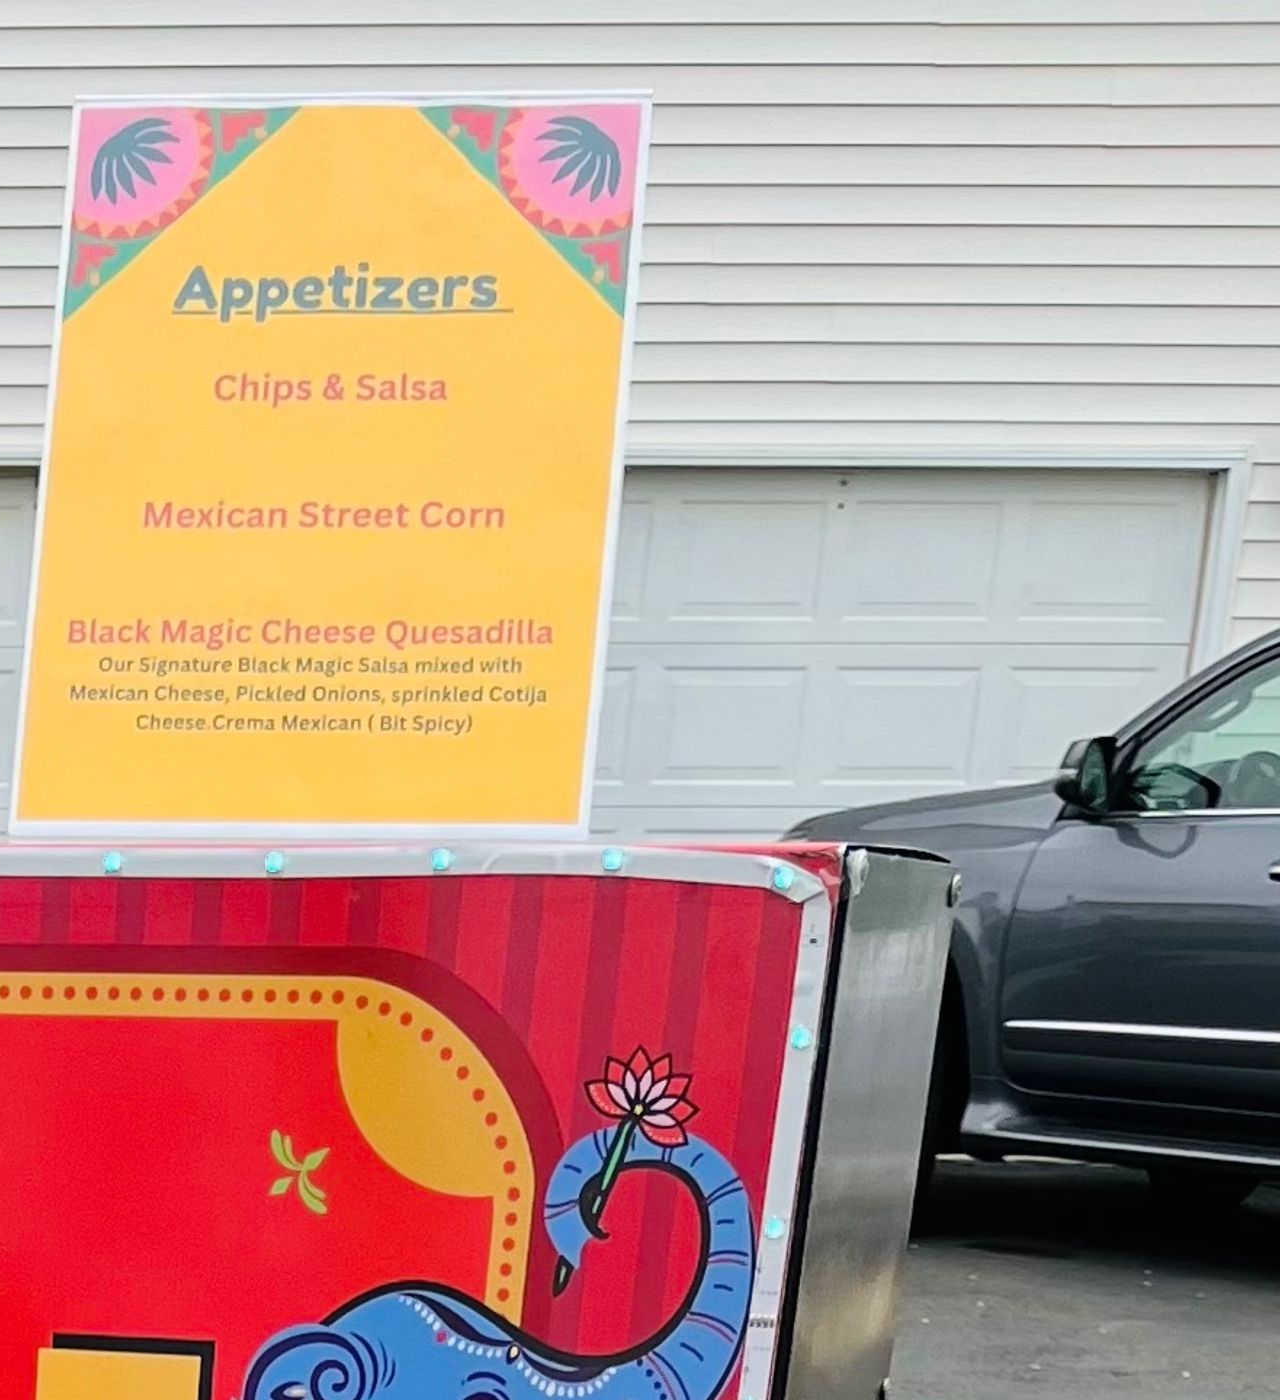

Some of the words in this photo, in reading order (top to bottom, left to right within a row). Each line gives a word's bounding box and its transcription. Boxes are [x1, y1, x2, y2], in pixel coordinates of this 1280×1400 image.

[173, 262, 498, 323] Appetizers
[213, 373, 312, 408] Chips
[322, 373, 345, 401] &
[356, 373, 448, 401] Salsa
[143, 499, 288, 528] Mexican
[298, 501, 409, 528] Street
[419, 501, 505, 528] Corn
[67, 618, 151, 644] Black
[160, 618, 253, 650] Magic
[261, 618, 376, 644] Cheese
[385, 618, 554, 650] Quesadilla
[98, 656, 134, 673] Our
[139, 656, 233, 677] Signature
[238, 656, 290, 673] Black
[296, 656, 353, 677] Magic
[358, 656, 409, 674] Salsa
[415, 657, 474, 674] mixed
[479, 657, 523, 674] with
[69, 683, 149, 701] Mexican
[154, 684, 231, 705] Cheese,
[236, 684, 306, 701] Pickled
[312, 685, 386, 705] Onions,
[391, 685, 483, 706] sprinkled
[489, 685, 547, 706] Cotija
[212, 714, 275, 731] Crema
[281, 714, 362, 731] Mexican
[412, 715, 474, 736] Spicy)
